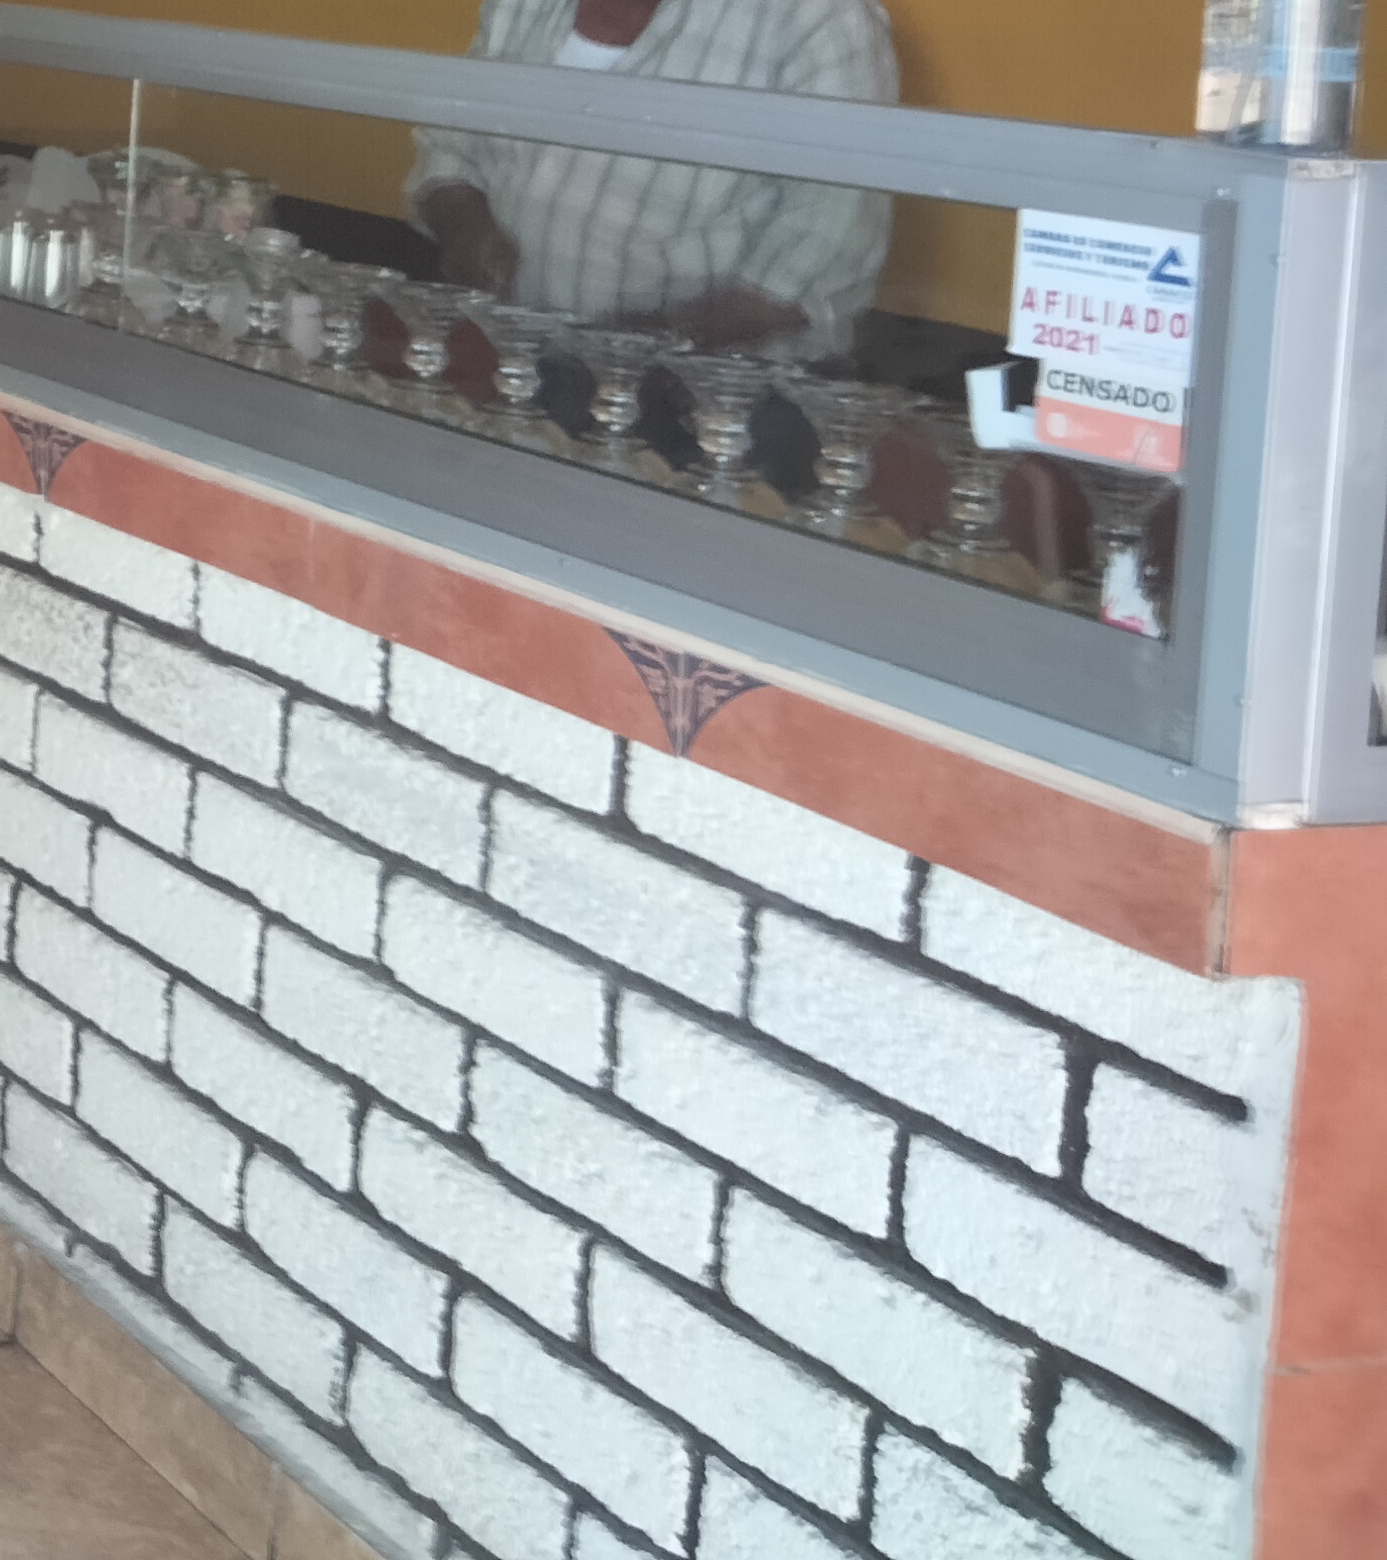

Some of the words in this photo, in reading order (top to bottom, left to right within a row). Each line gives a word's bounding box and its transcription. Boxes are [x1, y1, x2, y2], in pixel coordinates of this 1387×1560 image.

[1020, 286, 1192, 340] AFILIADO
[1031, 323, 1099, 354] 2021
[1046, 369, 1174, 413] CENSADO
